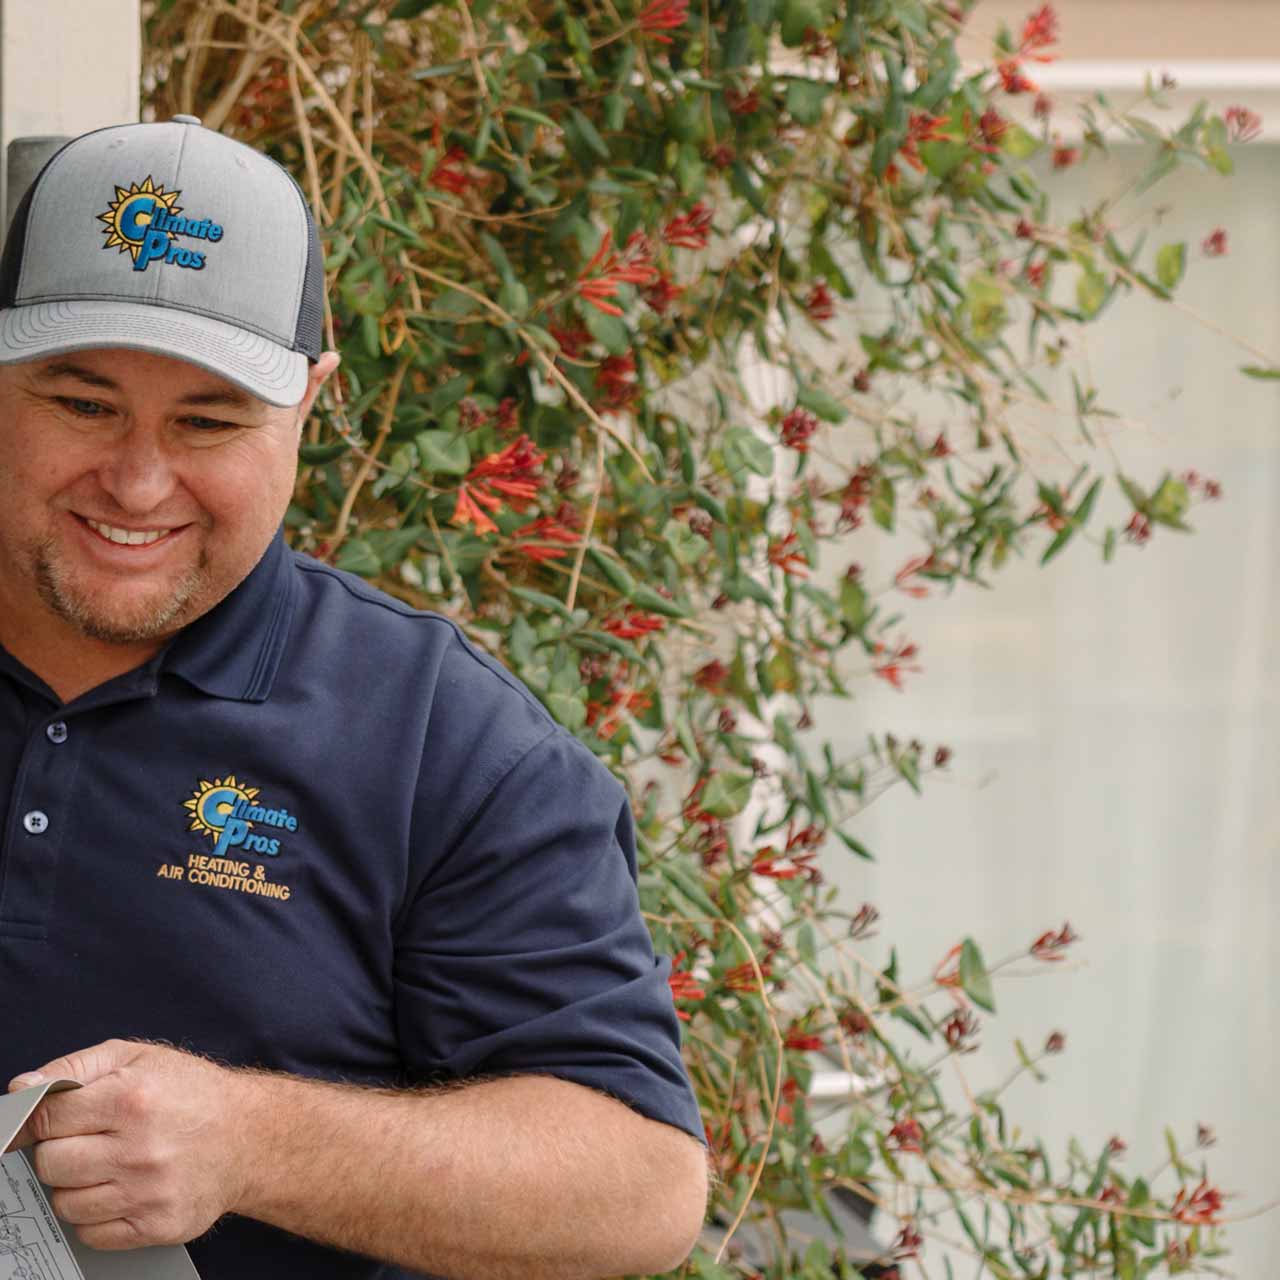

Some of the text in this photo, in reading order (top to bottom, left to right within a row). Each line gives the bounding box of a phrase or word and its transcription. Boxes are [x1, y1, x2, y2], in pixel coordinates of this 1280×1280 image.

[119, 197, 223, 242] Climate
[133, 231, 206, 271] Pros
[203, 790, 298, 833] Climate
[213, 817, 280, 857] Pros
[157, 864, 291, 901] AIR CONDITIONING
[187, 854, 266, 881] HEATING &
[26, 1178, 61, 1243] CONNECTION DIAGRAM
